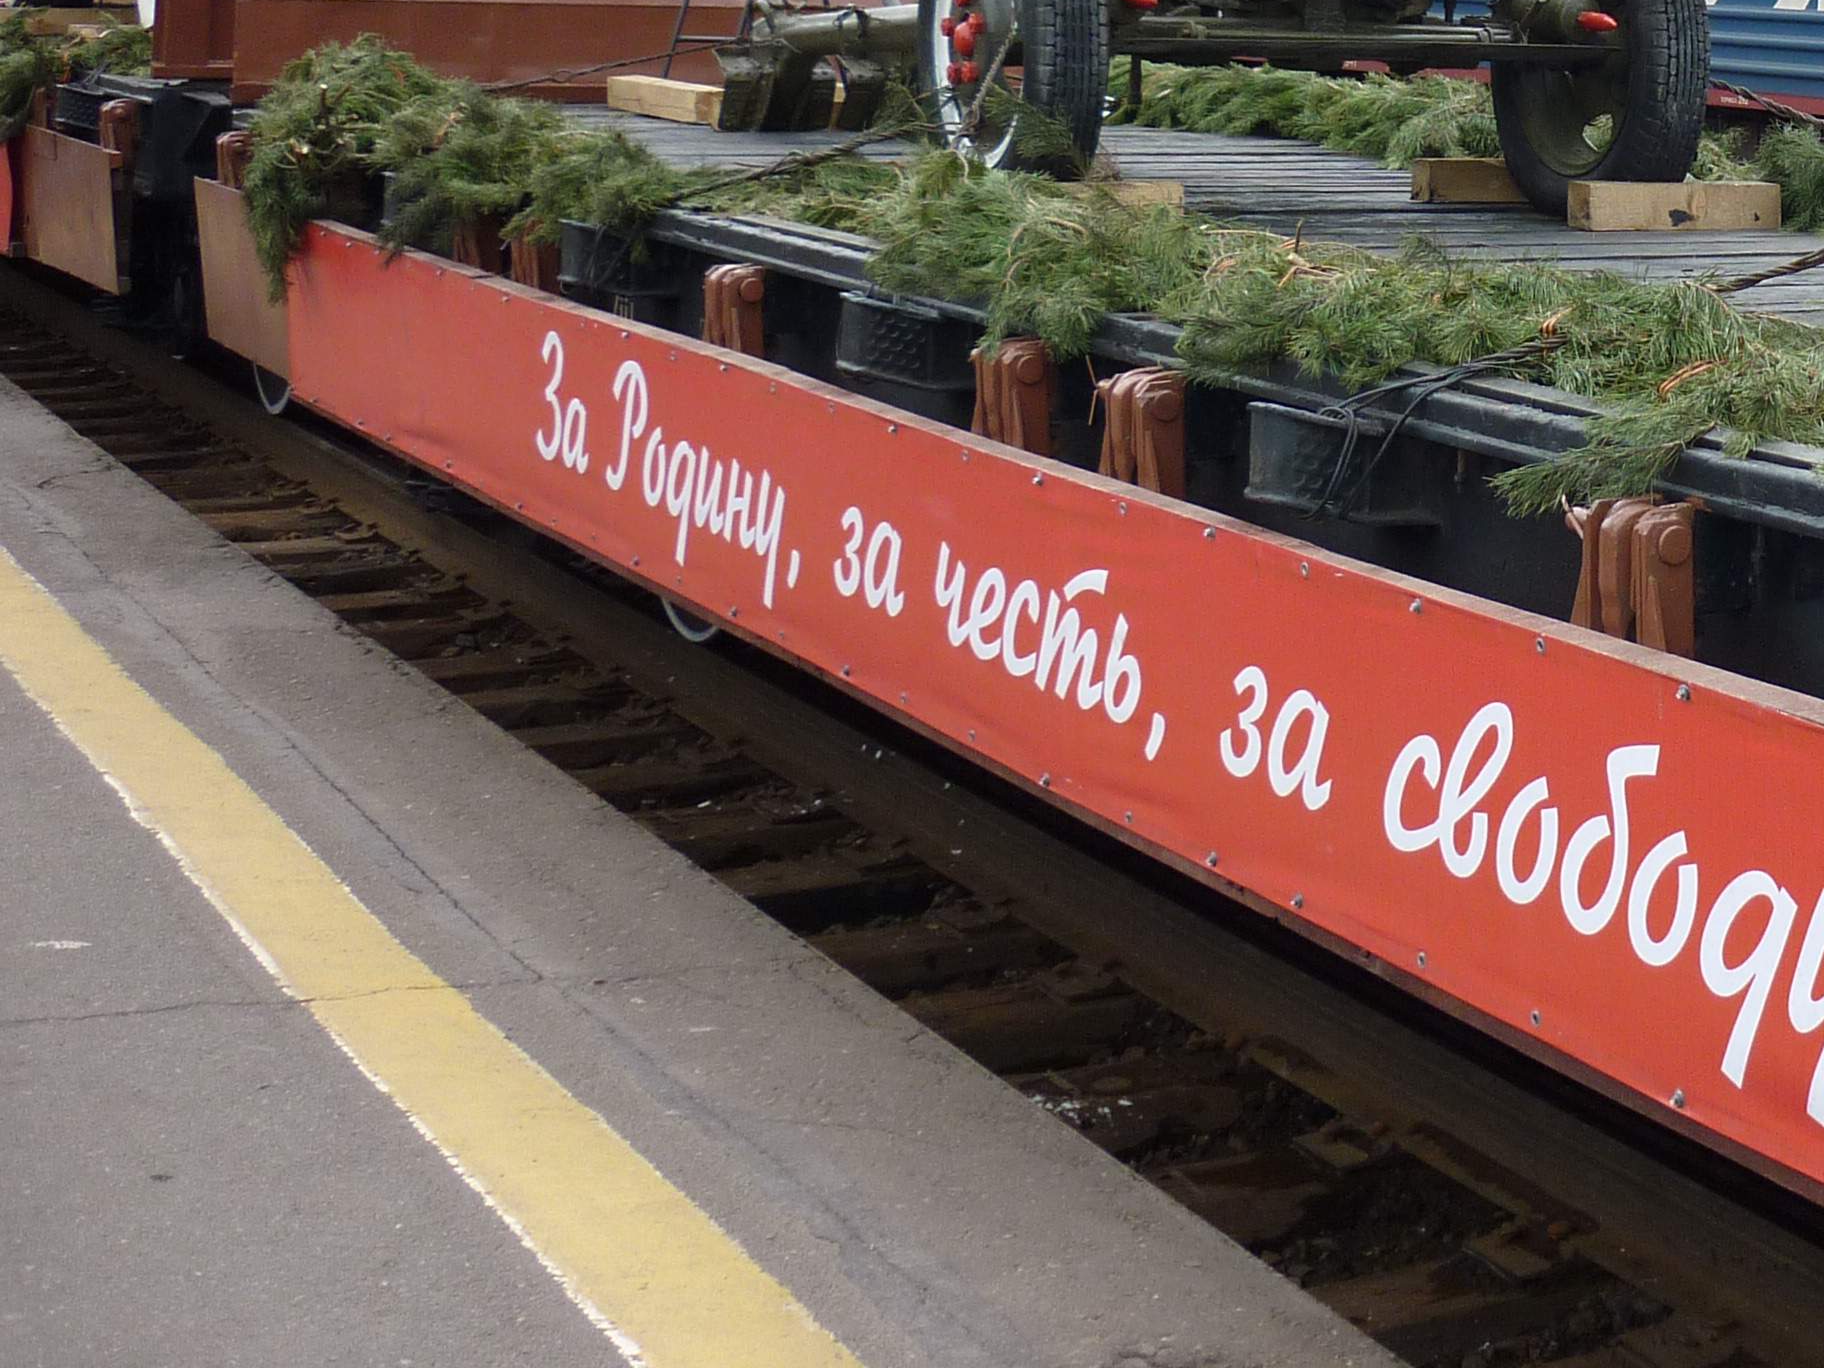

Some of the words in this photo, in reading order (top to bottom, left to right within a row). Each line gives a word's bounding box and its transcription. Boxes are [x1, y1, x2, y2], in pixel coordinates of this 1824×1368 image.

[536, 331, 589, 475] За
[606, 360, 801, 608] Родину,
[834, 507, 905, 617] за
[935, 541, 1166, 761] честь,
[1220, 665, 1333, 811] за
